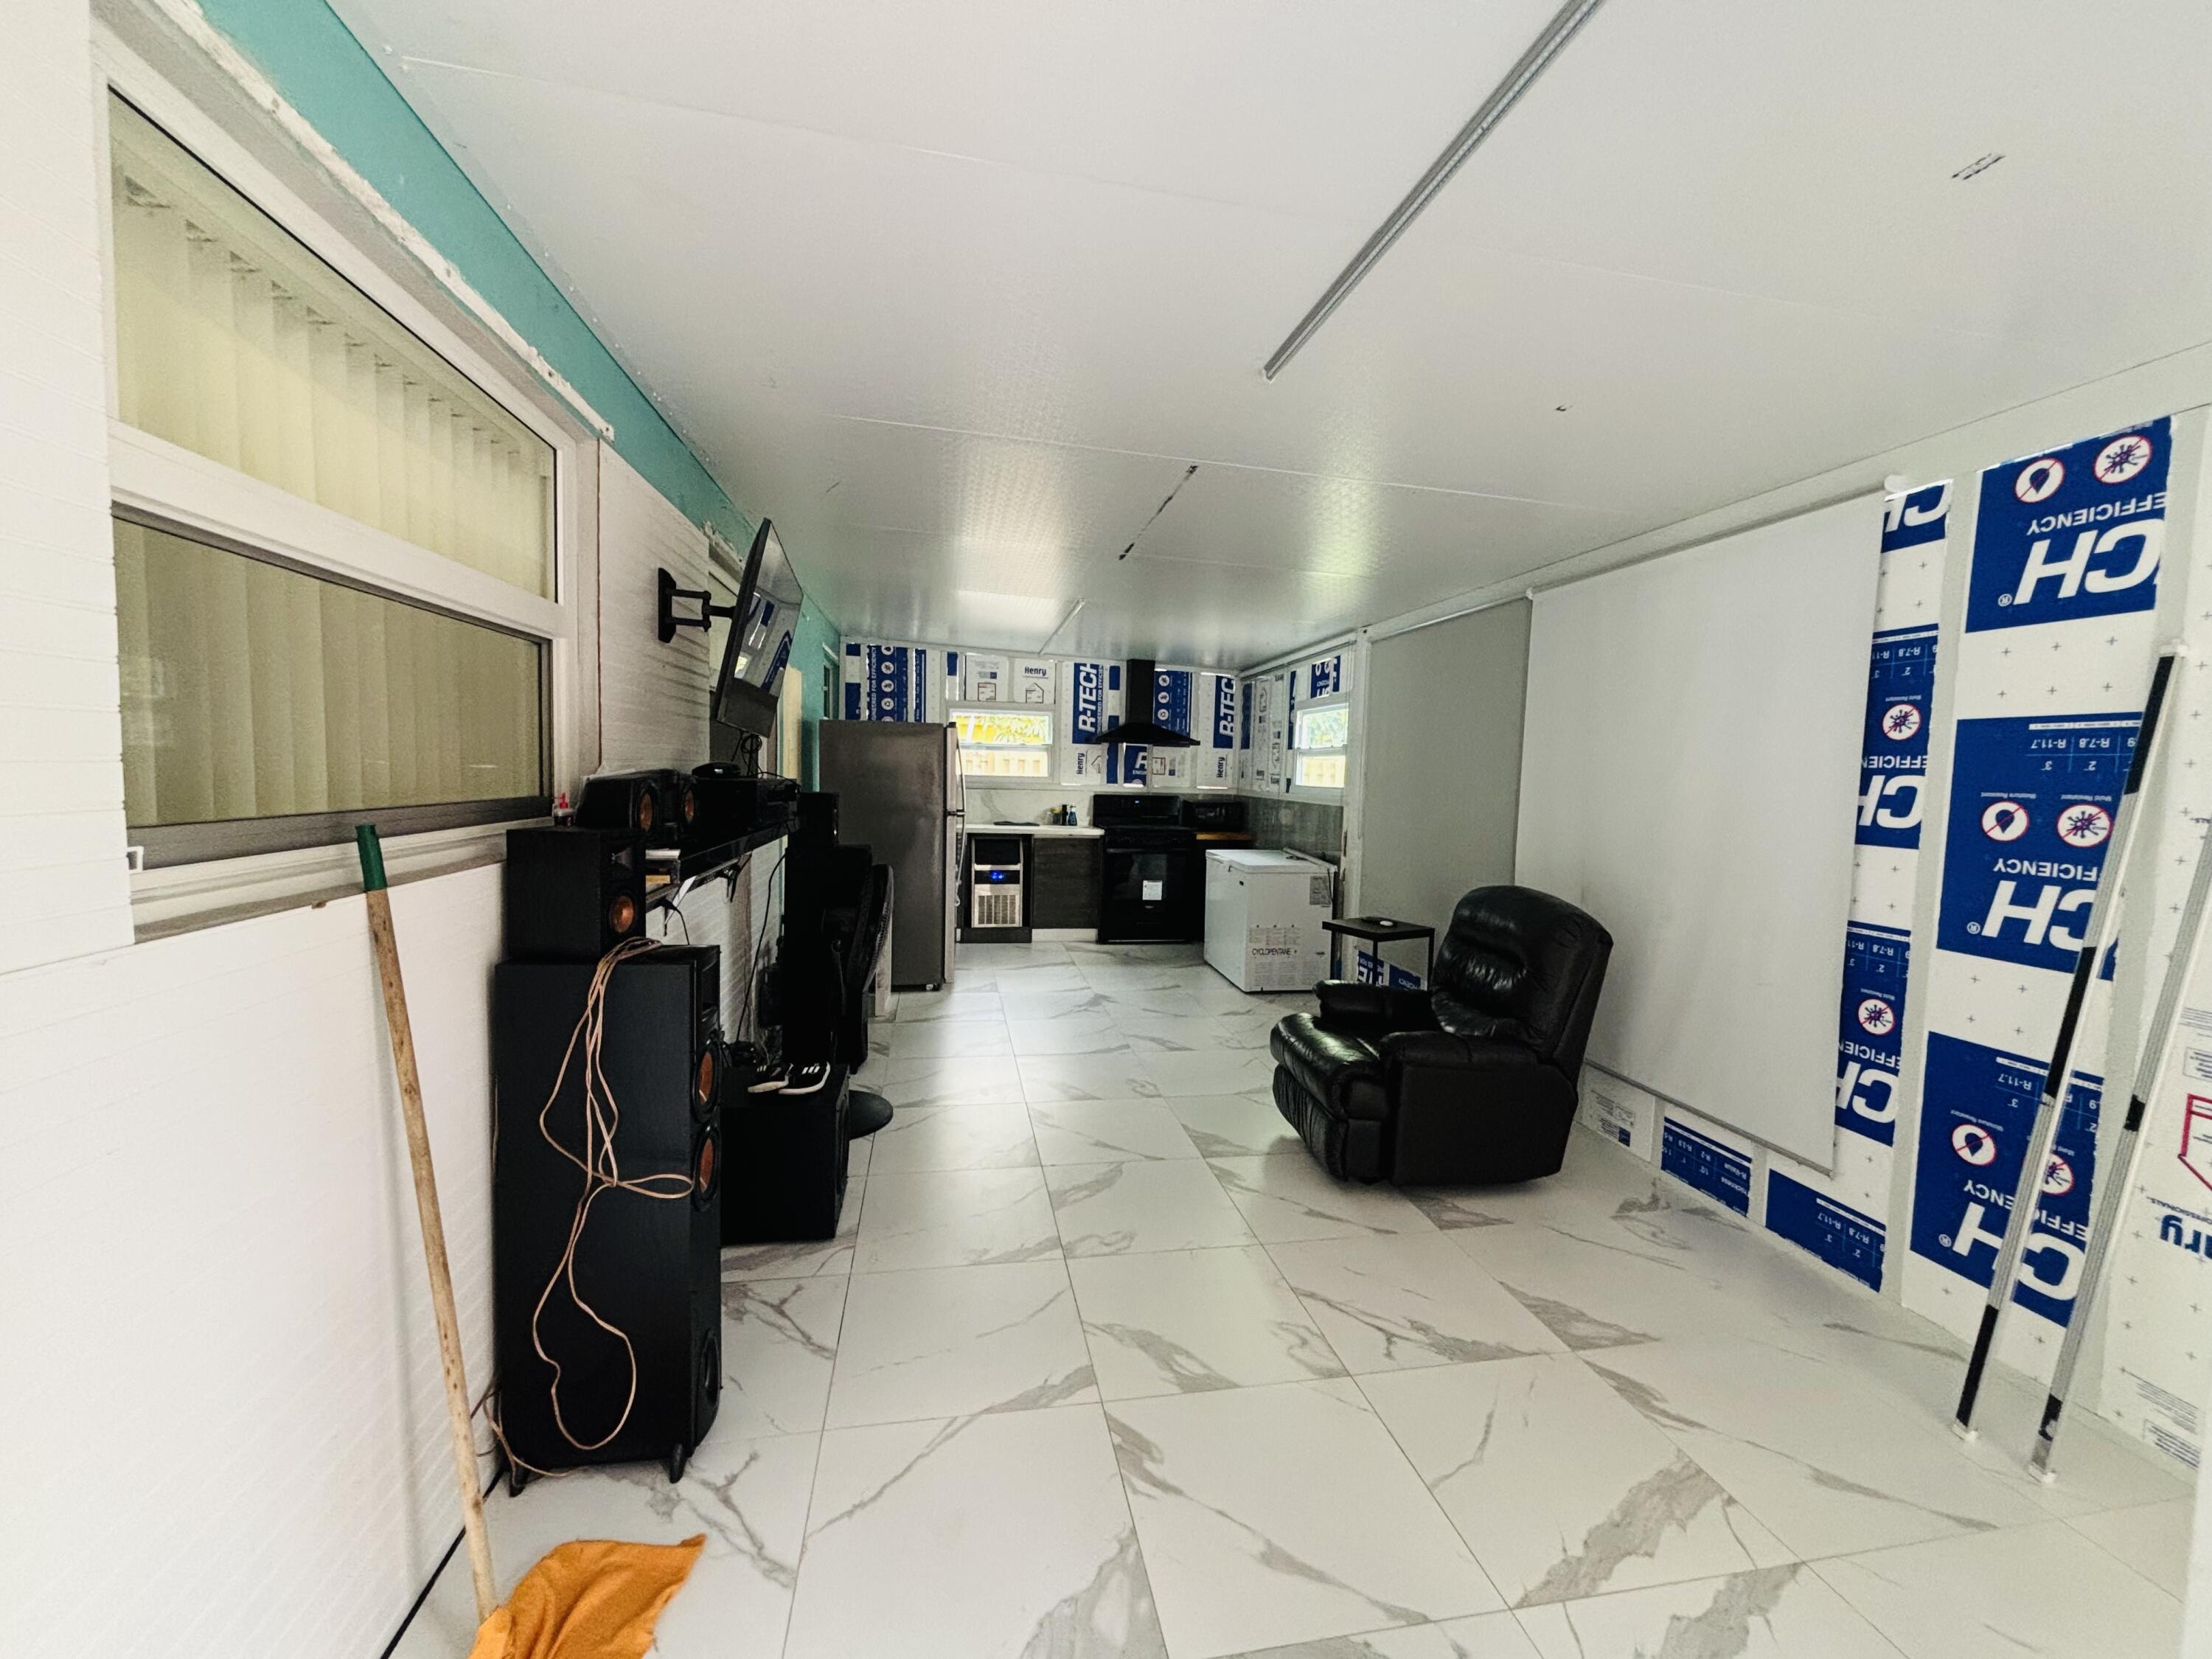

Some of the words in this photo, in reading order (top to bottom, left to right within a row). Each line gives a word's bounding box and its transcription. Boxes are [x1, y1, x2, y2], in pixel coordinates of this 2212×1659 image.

[2026, 492, 2166, 536] EFFICIENCY
[1024, 666, 1046, 677] Henry
[1219, 678, 1236, 737] R-TEC
[2030, 737, 2067, 750] R-11.7
[2079, 737, 2110, 748] R-7.8
[1076, 752, 1085, 774] Henry
[1216, 757, 1225, 779] Henry
[1860, 754, 1928, 770] EFFICIEN
[1992, 858, 2103, 882] FICIENCY
[1872, 944, 1894, 956] R-7.8
[1838, 1038, 1902, 1070] EFFICIEN
[1997, 1072, 2032, 1091] R-11.7
[1962, 1178, 2089, 1240] EFFIENCY
[1817, 1211, 1842, 1230] R-11.7
[1848, 1227, 1870, 1244] R-7.8
